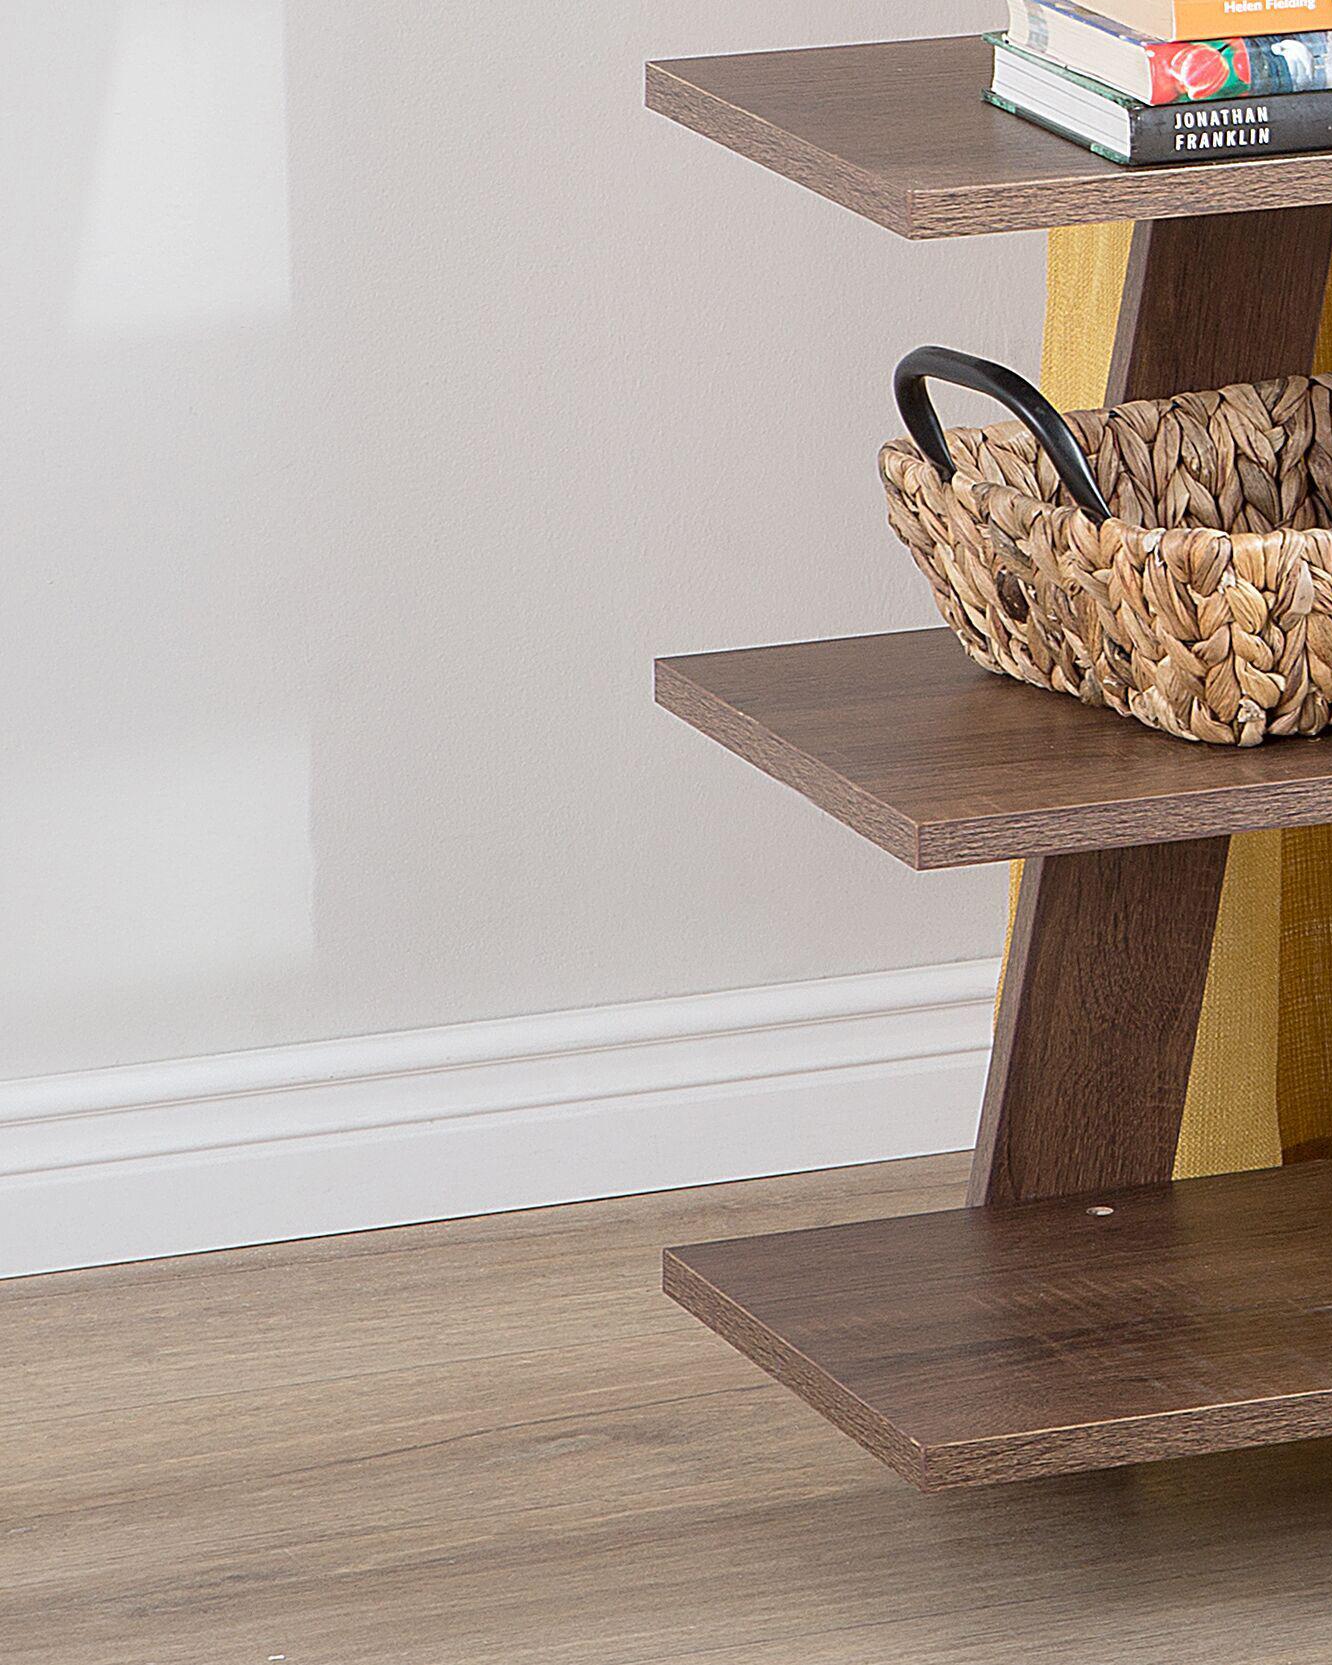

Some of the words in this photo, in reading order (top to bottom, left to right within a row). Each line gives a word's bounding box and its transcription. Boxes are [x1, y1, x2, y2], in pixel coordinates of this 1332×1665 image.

[1223, 0, 1263, 14] Helen
[1174, 106, 1269, 130] JONATHAN
[1175, 127, 1271, 151] FRANKLIN
